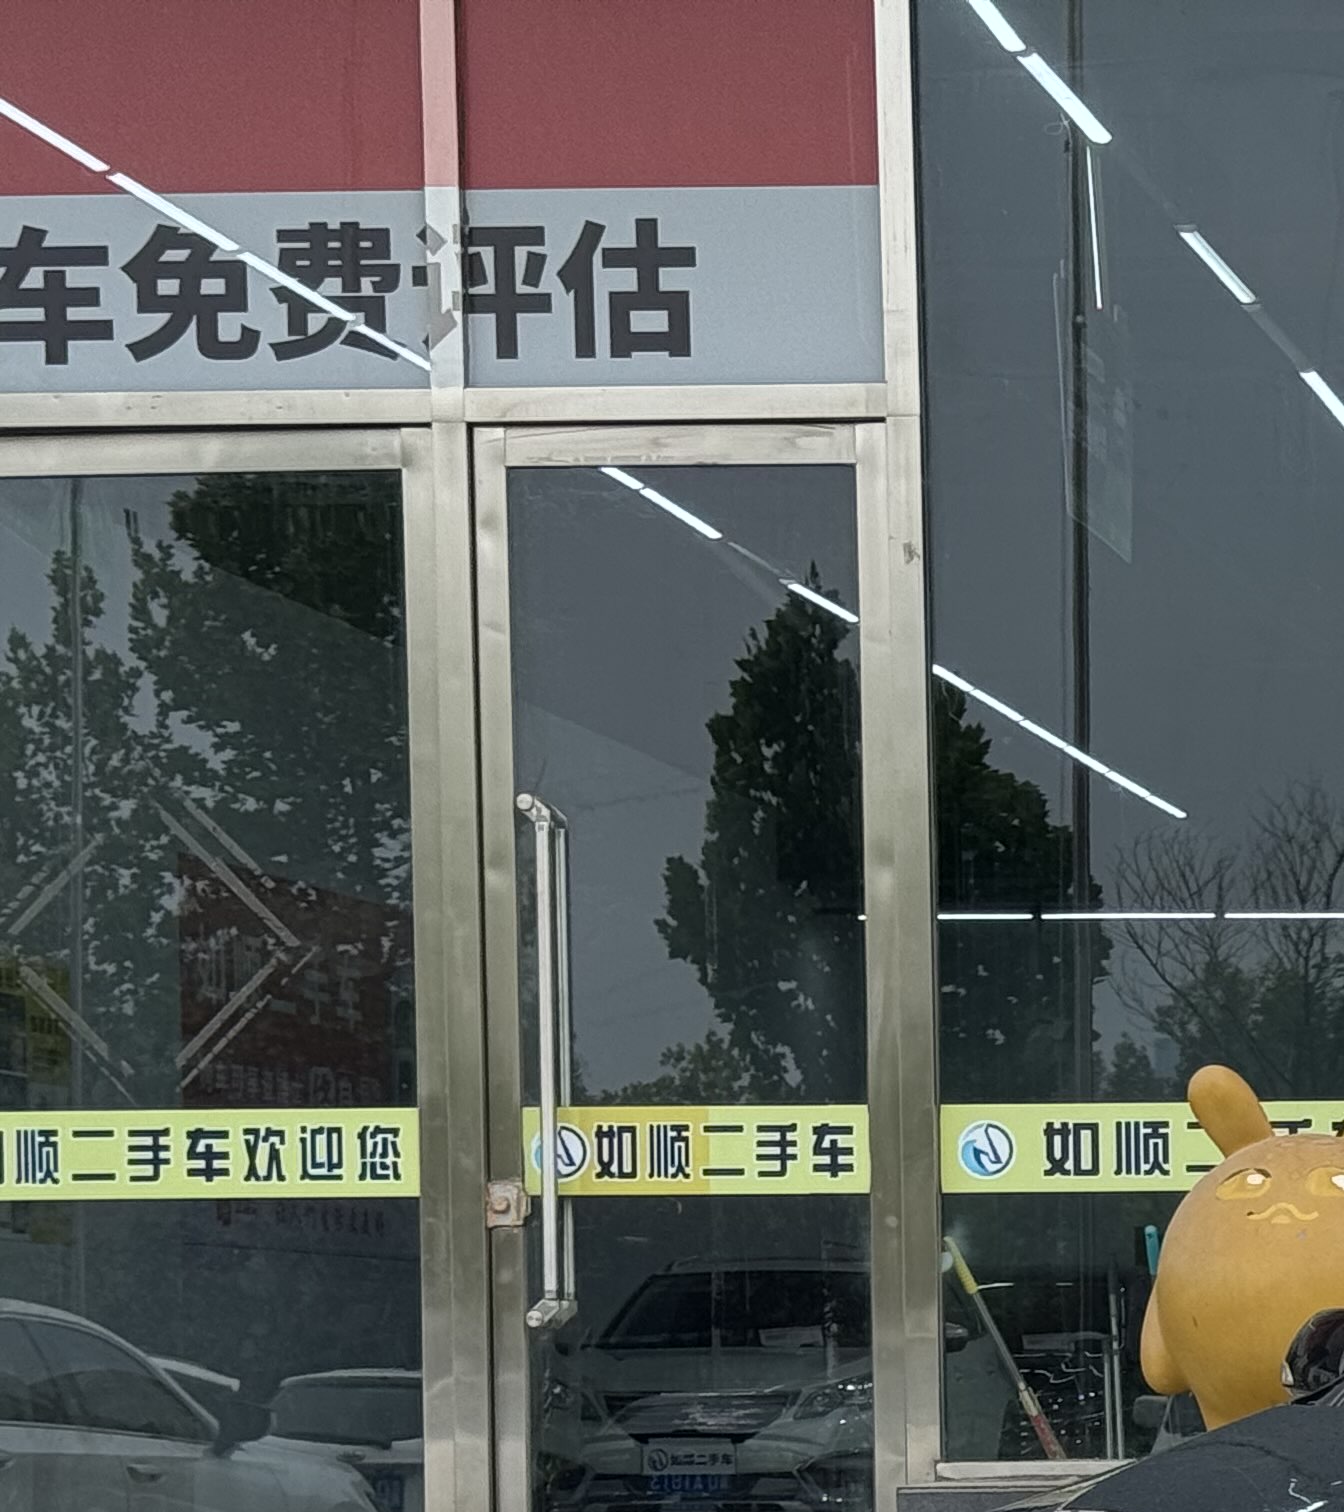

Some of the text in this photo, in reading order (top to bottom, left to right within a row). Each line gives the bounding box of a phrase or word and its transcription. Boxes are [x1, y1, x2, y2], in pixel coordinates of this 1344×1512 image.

[0, 217, 697, 366] 车免费评估
[0, 1126, 402, 1185] 顺二手车欢迎您
[594, 1122, 854, 1179] 如顺二手车
